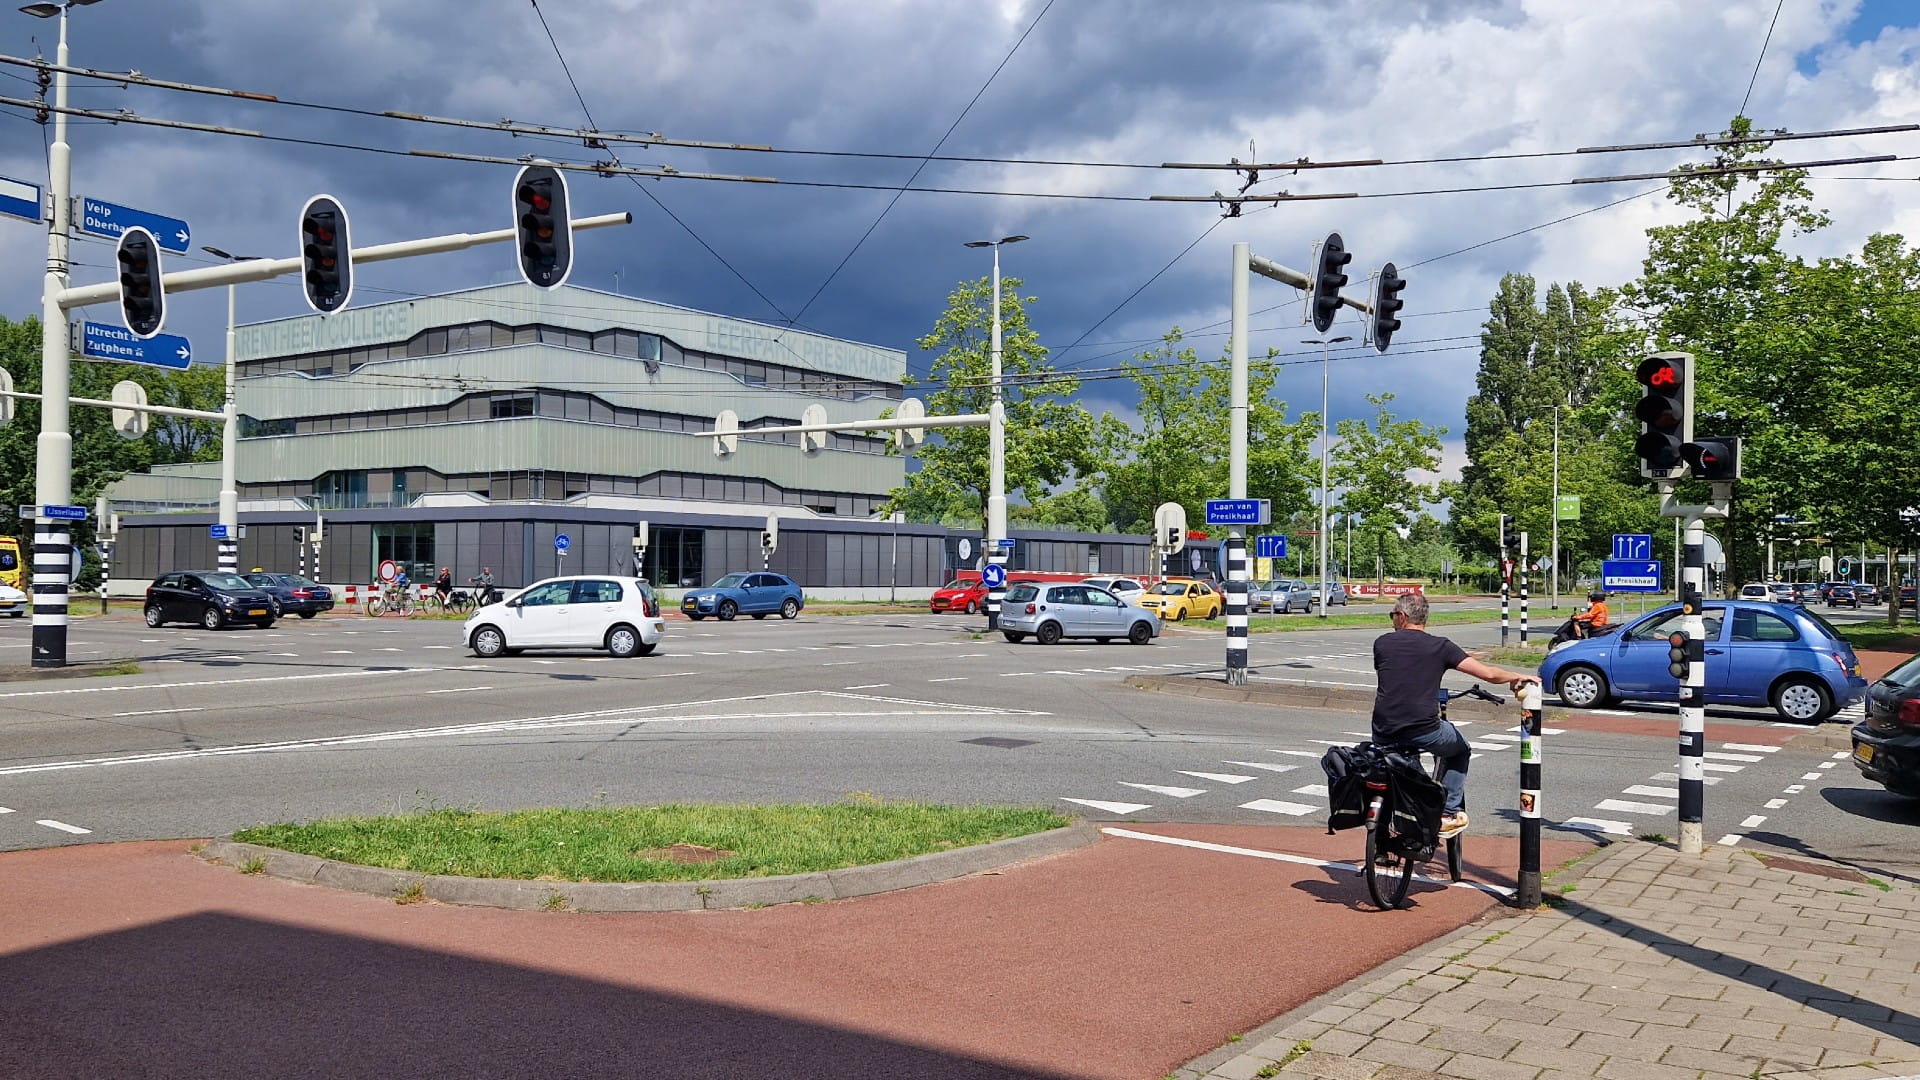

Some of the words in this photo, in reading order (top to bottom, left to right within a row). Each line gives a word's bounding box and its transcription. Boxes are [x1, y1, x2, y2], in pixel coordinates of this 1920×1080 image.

[86, 202, 112, 217] Velp
[85, 216, 128, 234] Oberha
[328, 306, 407, 344] COLLEGE
[86, 325, 129, 341] Utrecht
[87, 340, 133, 355] Zutphen
[1213, 503, 1234, 511] Laan
[1210, 512, 1255, 520] Presikhaaf
[1366, 585, 1415, 594] Hoodingang
